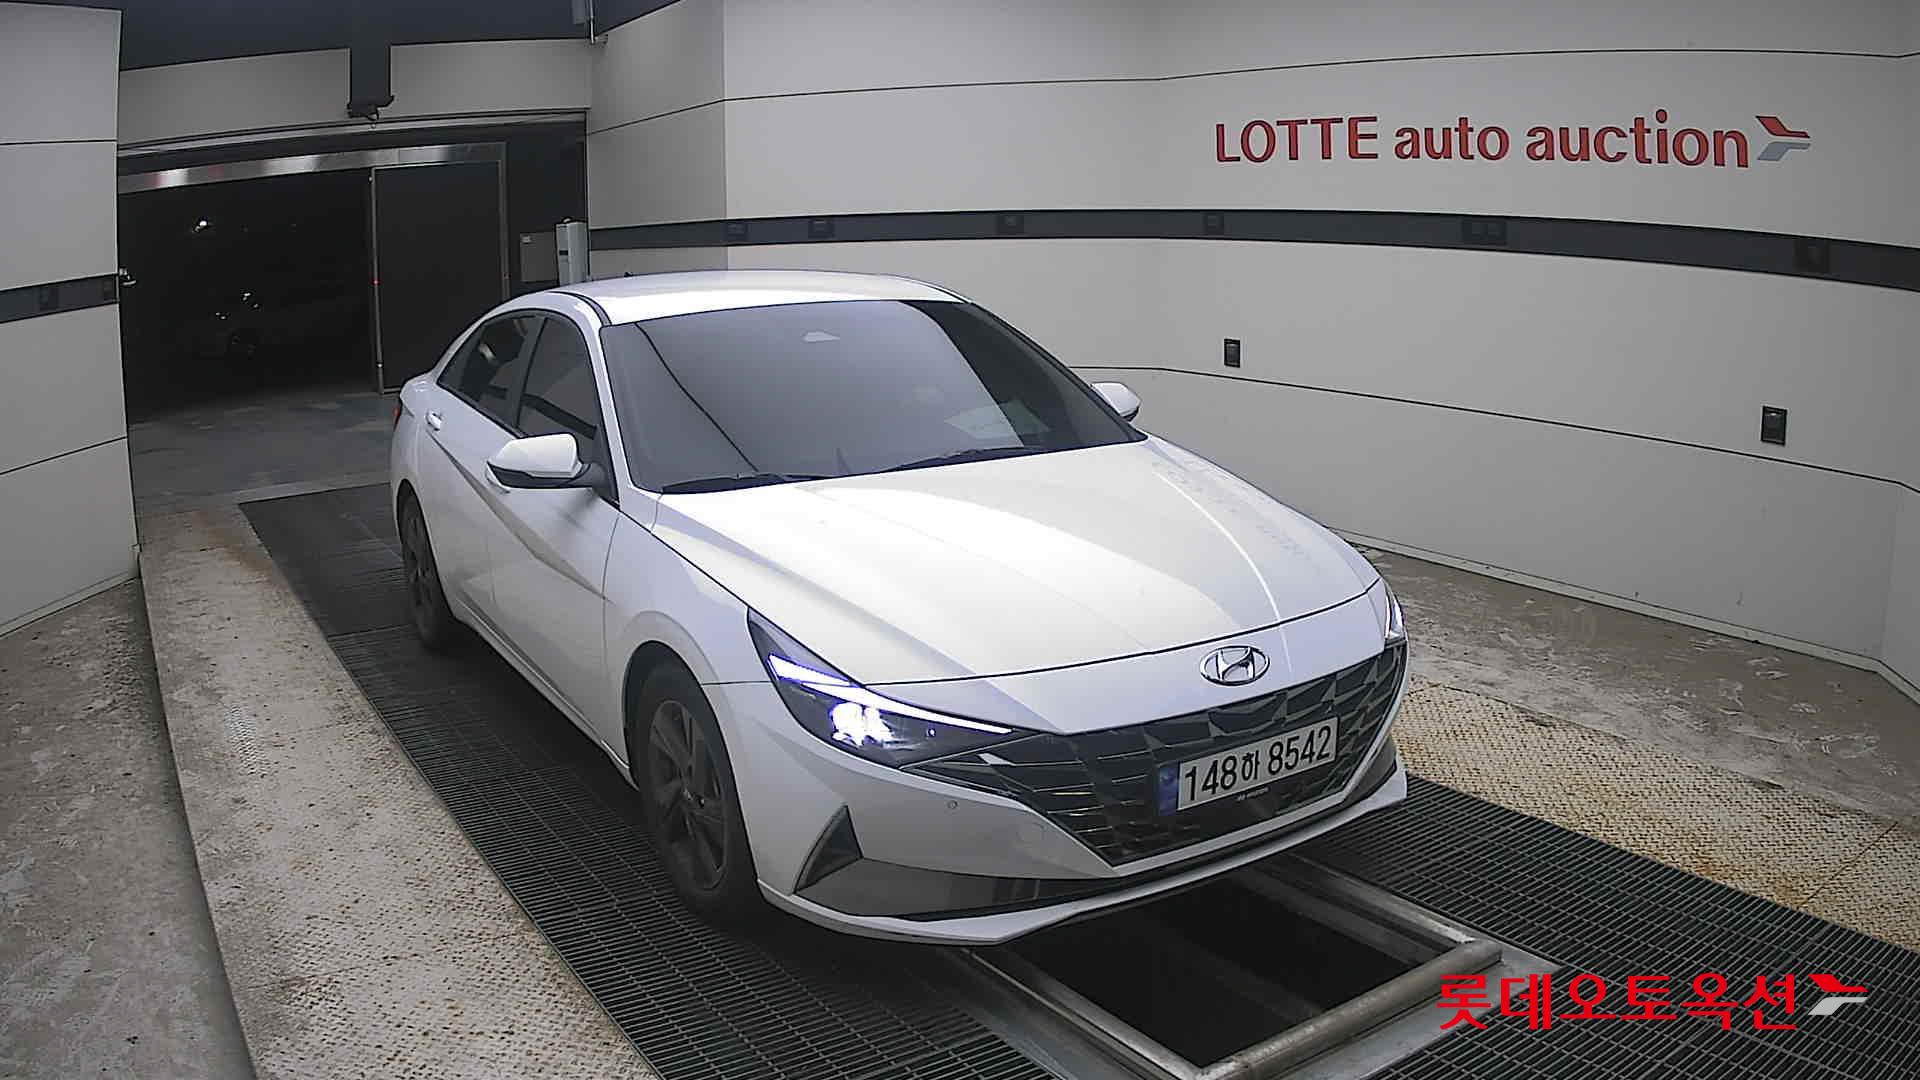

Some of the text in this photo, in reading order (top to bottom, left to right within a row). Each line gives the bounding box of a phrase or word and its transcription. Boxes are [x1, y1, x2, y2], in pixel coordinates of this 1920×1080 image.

[1215, 108, 1750, 168] LOTTE auto auction
[1185, 725, 1332, 801] 148하 8542
